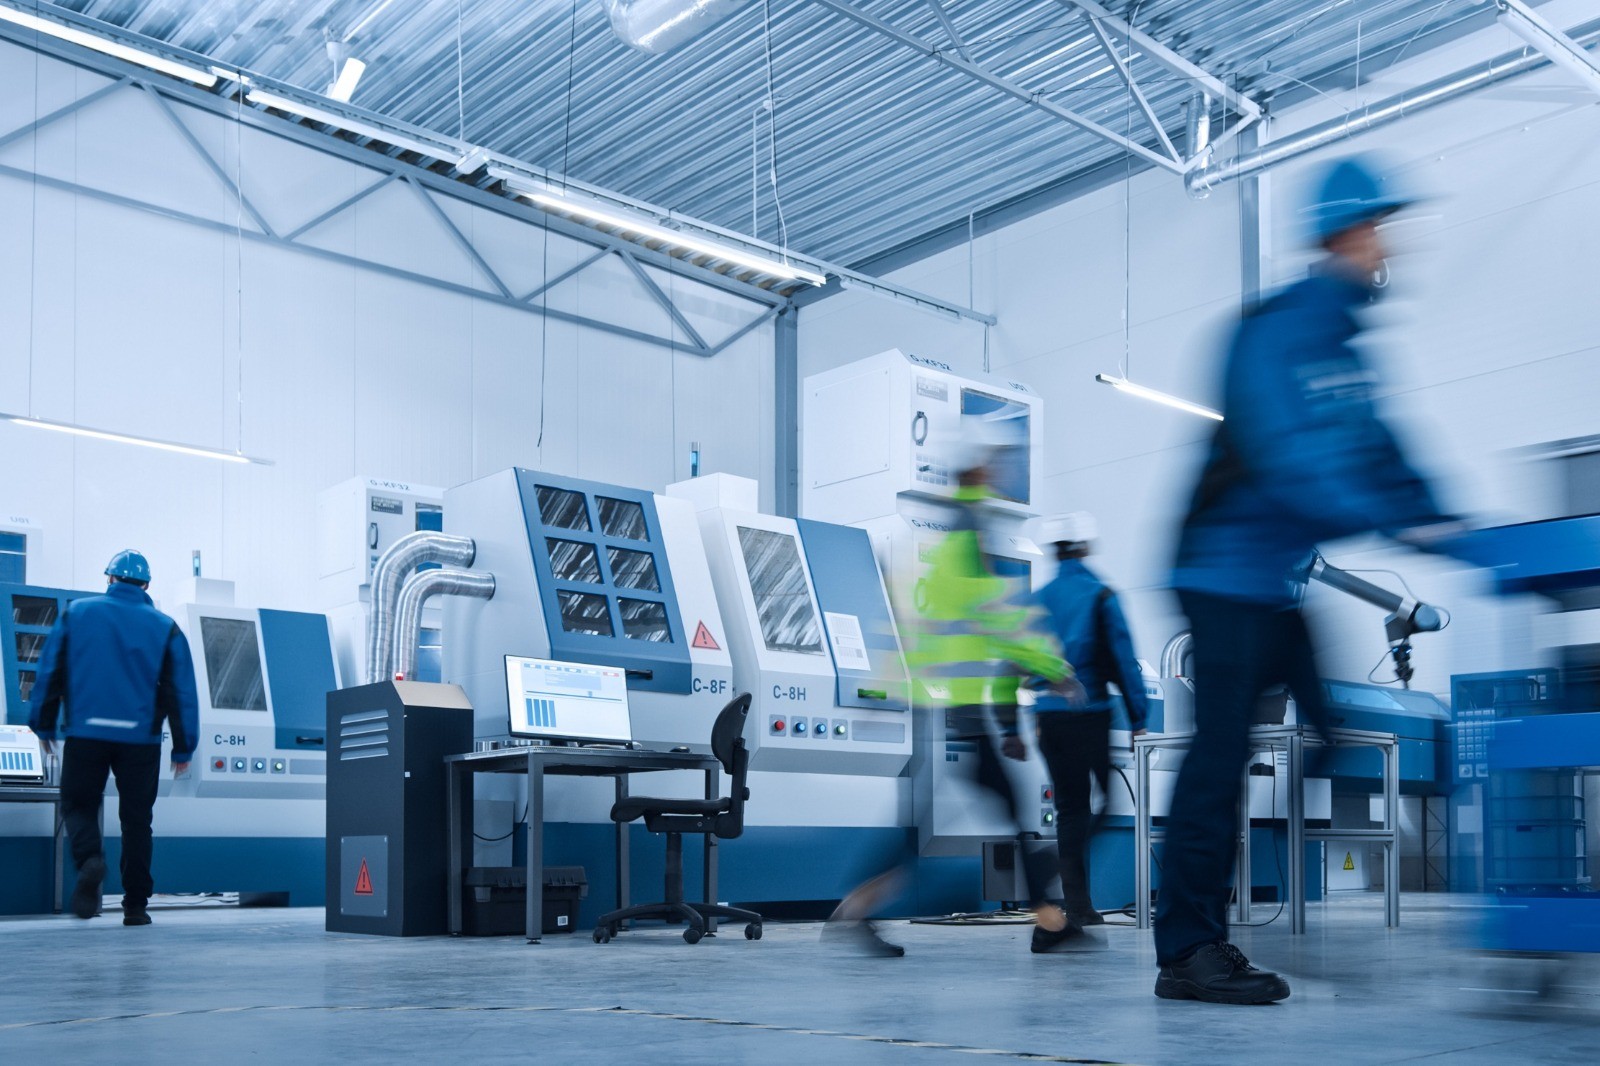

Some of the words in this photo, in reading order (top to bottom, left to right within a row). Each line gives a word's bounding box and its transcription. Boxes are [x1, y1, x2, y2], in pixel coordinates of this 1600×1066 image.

[909, 354, 953, 372] G-KF32
[369, 479, 411, 492] G-KF32
[692, 677, 727, 695] C-8F
[772, 685, 806, 701] C-8H
[214, 734, 246, 746] C-8H
